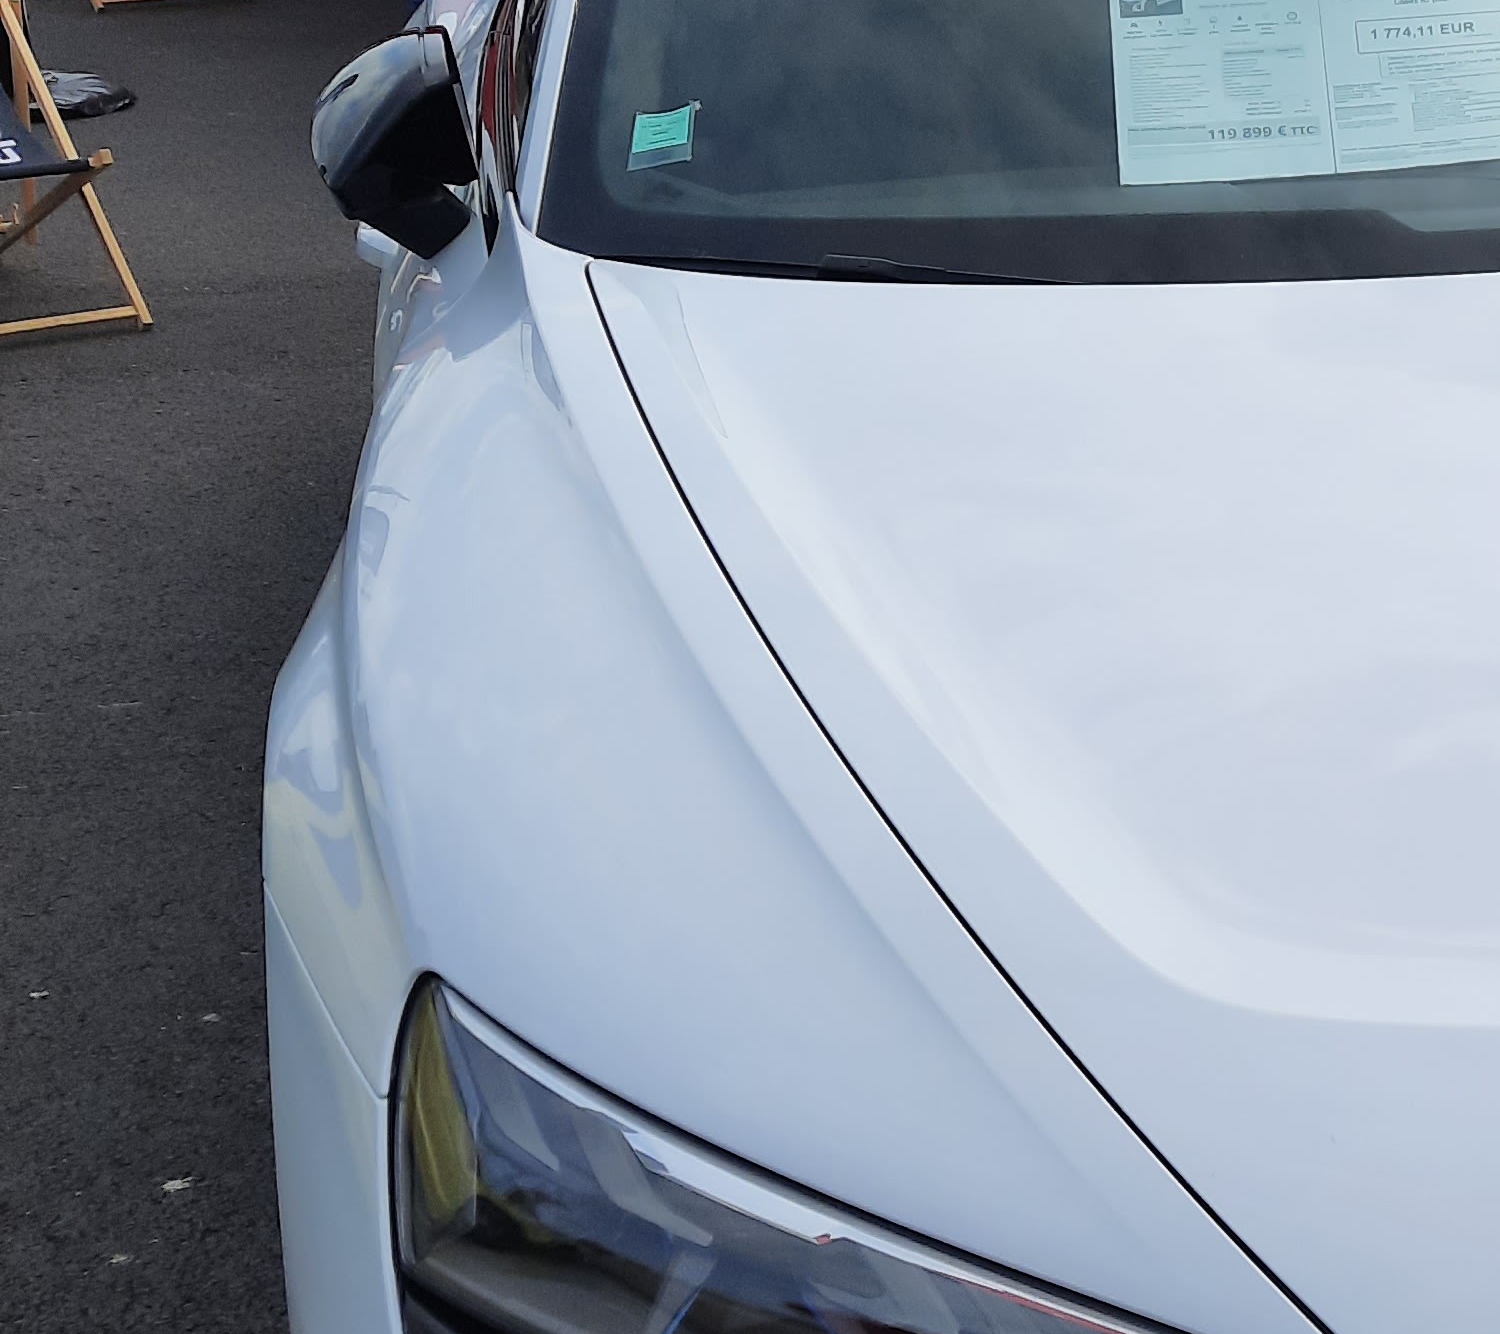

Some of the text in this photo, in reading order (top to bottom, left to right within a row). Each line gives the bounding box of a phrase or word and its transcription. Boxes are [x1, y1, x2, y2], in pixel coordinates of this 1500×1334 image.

[1369, 21, 1476, 41] 1 774,11 EUR
[1208, 127, 1237, 140] 119
[1242, 126, 1273, 139] 899
[1277, 125, 1287, 137] €
[1291, 125, 1316, 136] TTC
